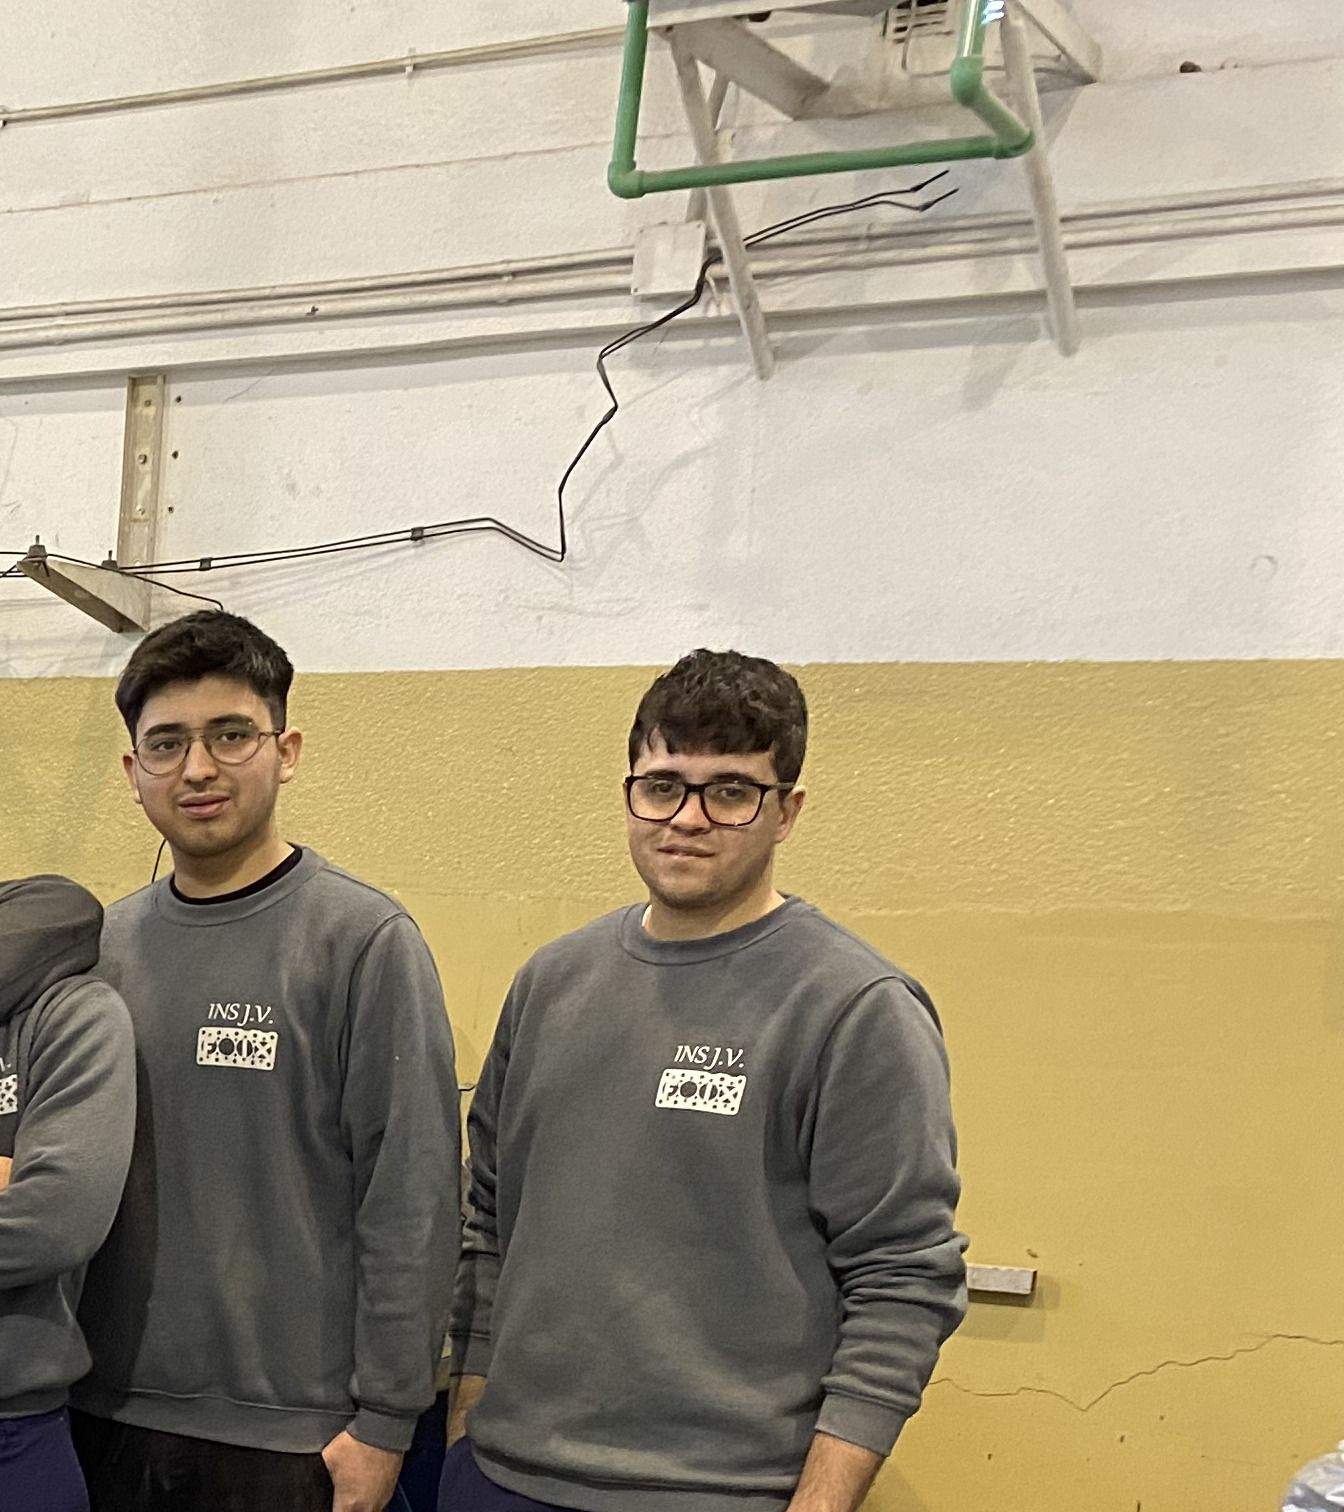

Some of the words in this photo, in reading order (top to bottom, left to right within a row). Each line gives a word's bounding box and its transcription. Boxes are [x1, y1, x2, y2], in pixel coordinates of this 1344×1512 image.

[208, 1002, 240, 1020] INS
[236, 1003, 274, 1027] J.V.
[674, 1045, 710, 1064] INS
[703, 1047, 745, 1070] J.V.
